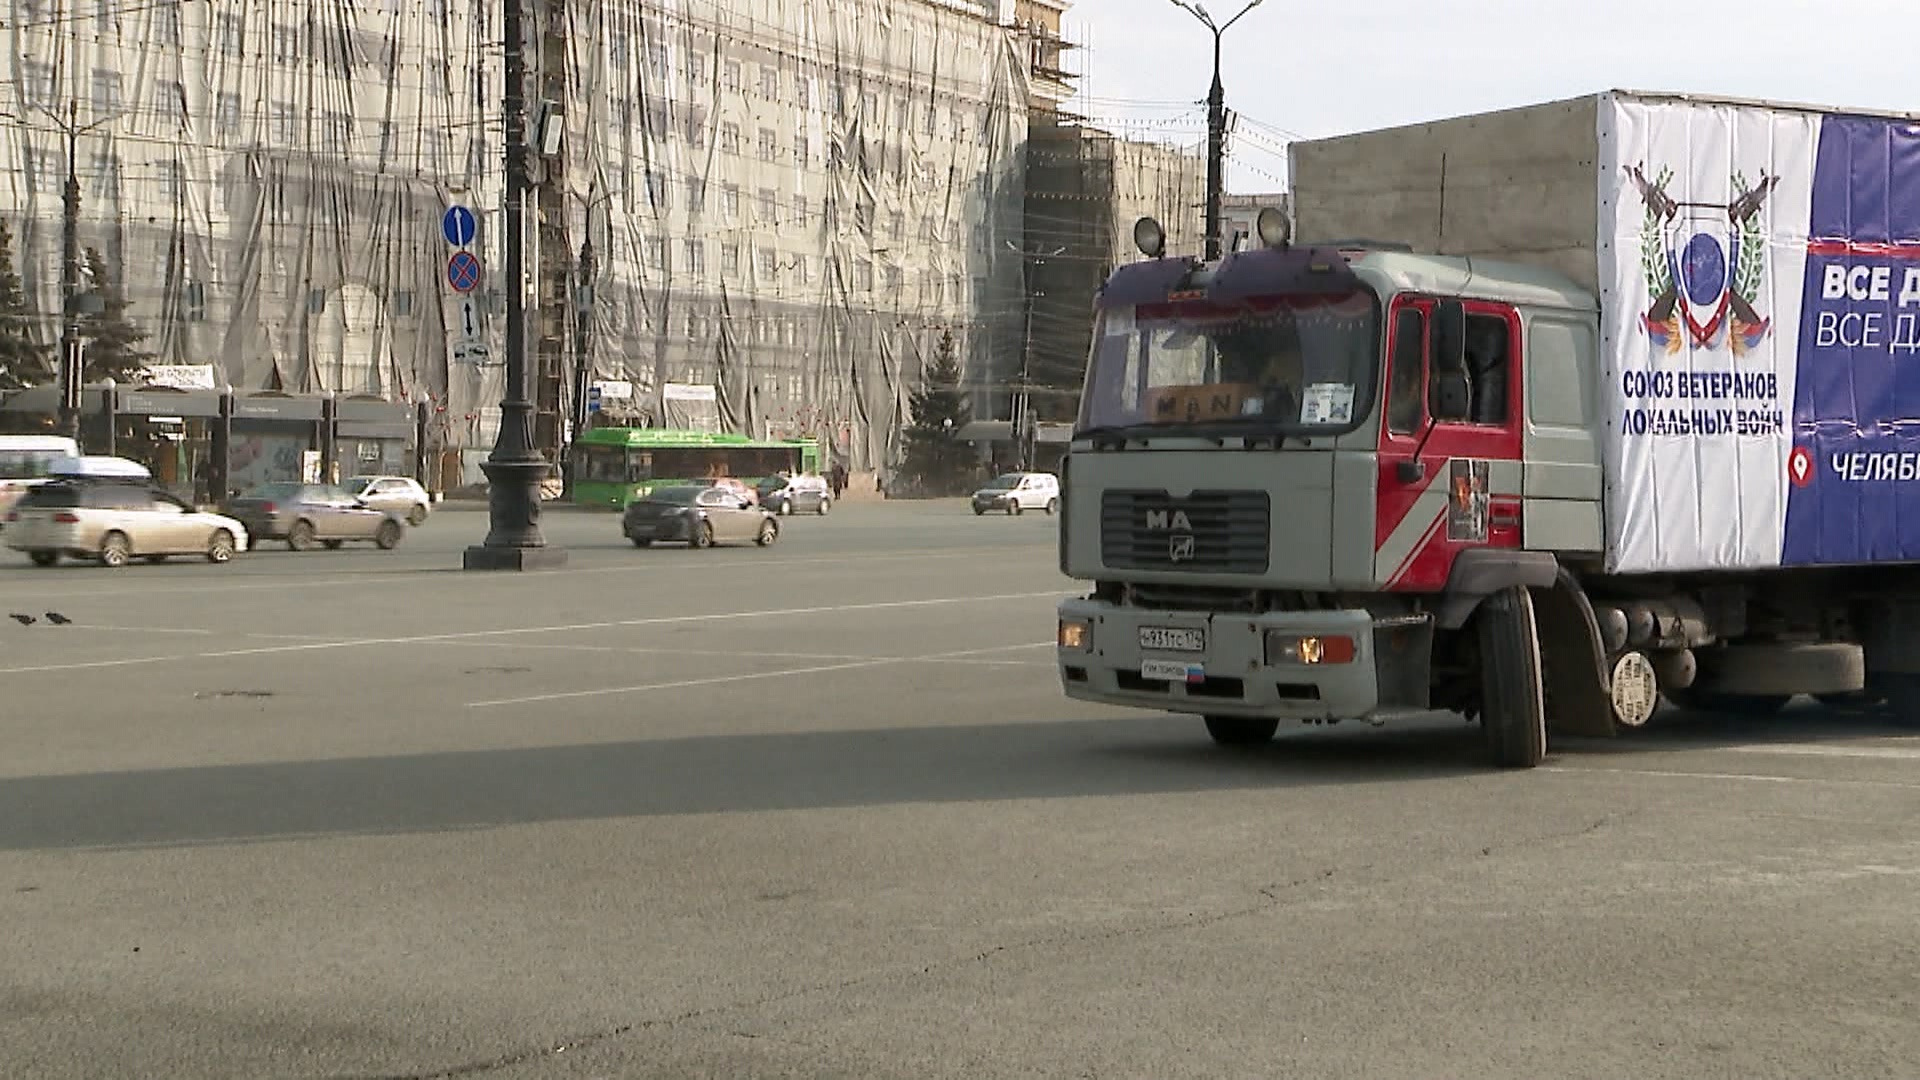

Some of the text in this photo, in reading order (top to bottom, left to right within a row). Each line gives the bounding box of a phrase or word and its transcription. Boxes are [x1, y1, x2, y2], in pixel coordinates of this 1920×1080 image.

[1822, 264, 1891, 300] ВСЕ
[1816, 311, 1920, 354] ВСЕ Д
[1623, 370, 1777, 399] СОЮЗ ВЕТЕРАНОВ
[1622, 402, 1783, 435] ЛОКАЛЬНЫХ ВОЙН
[1832, 453, 1920, 480] ЧЕЛЯБ
